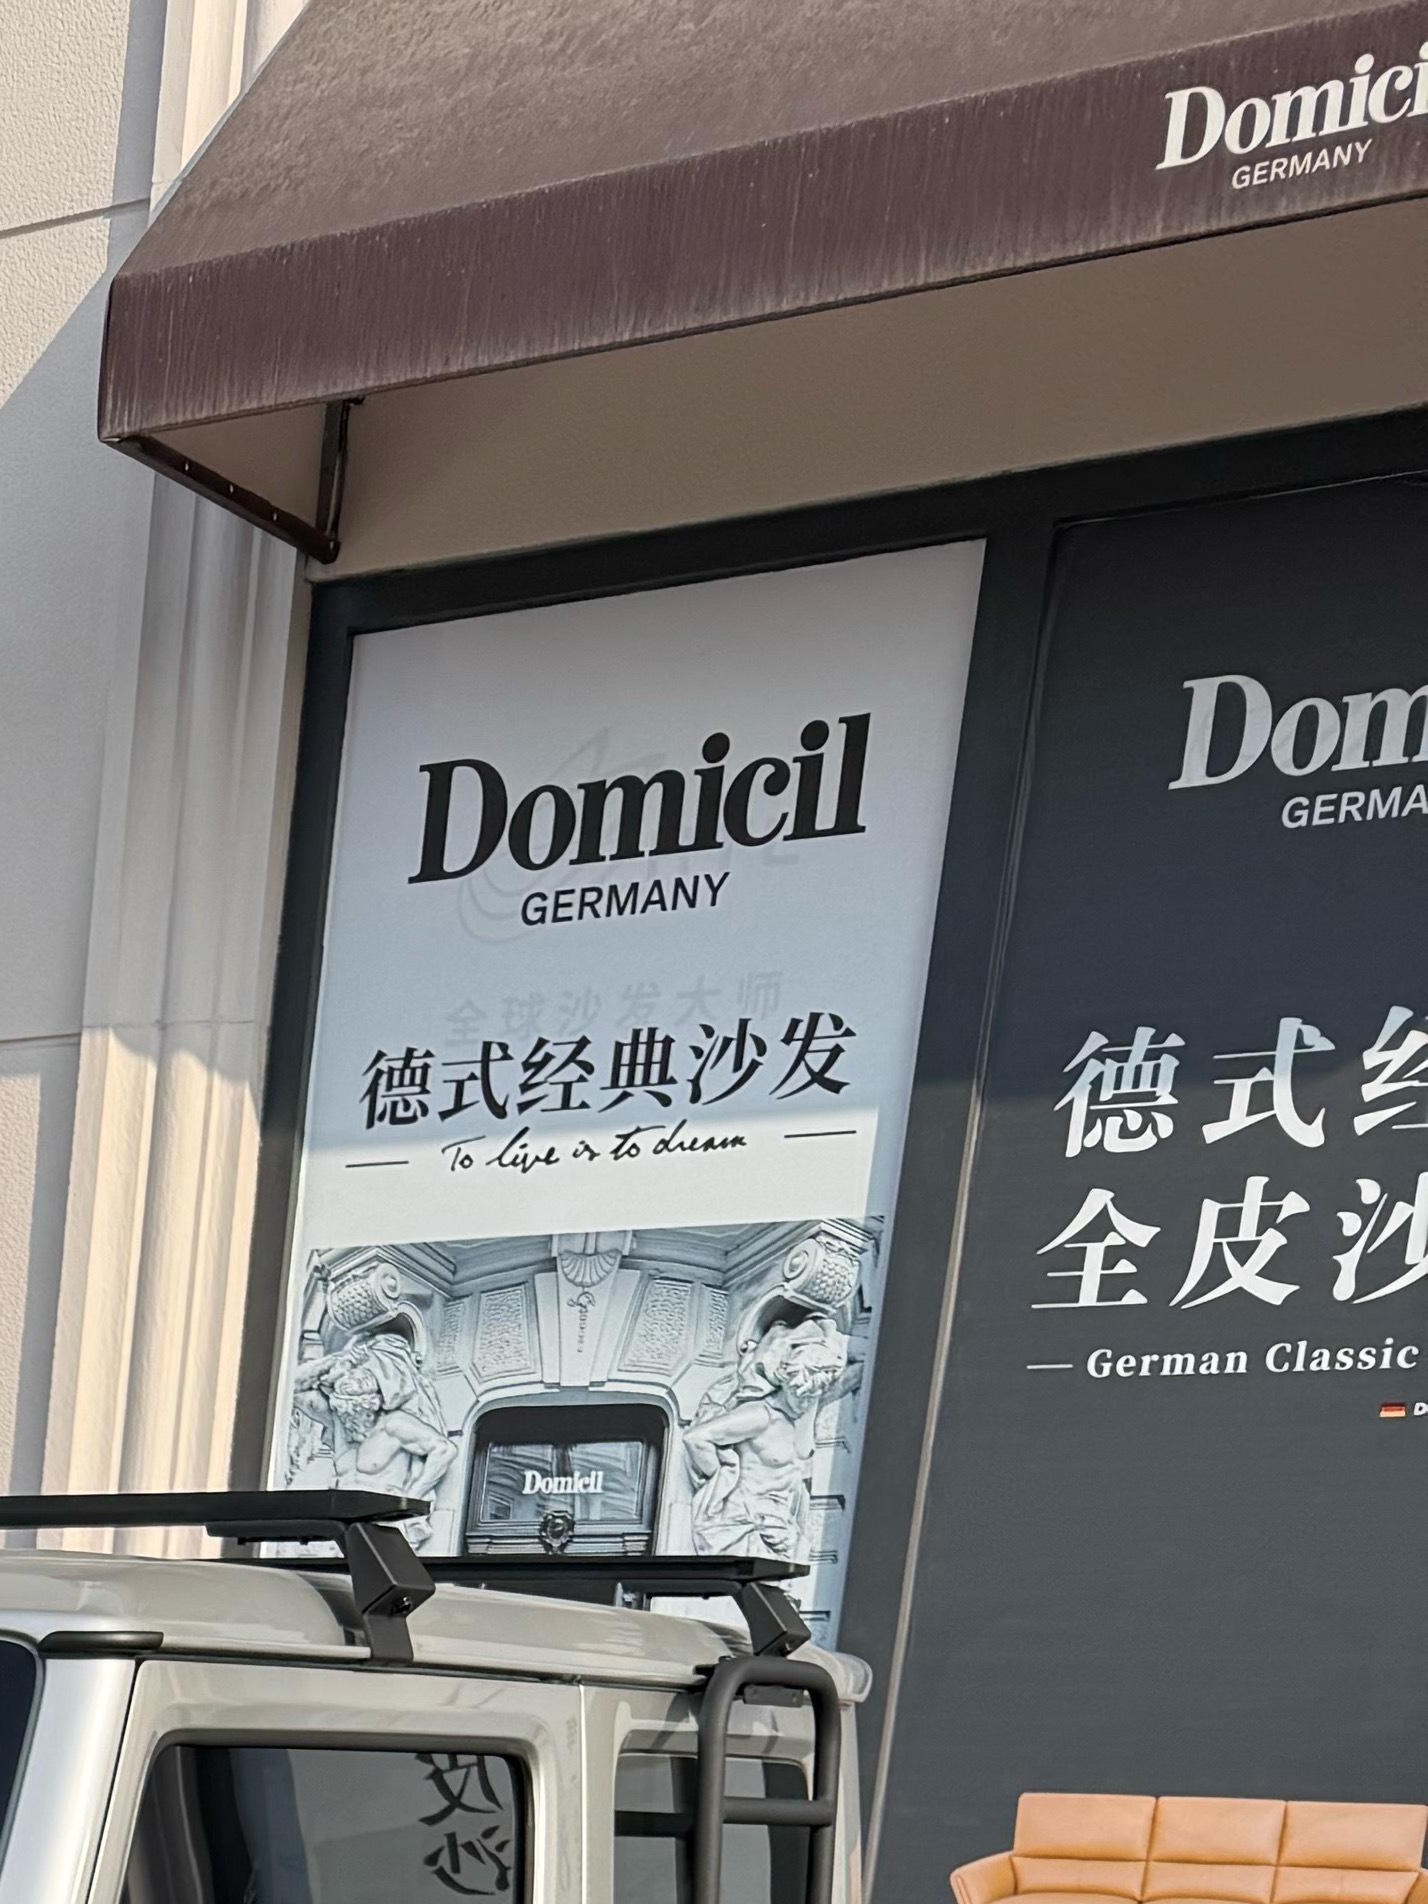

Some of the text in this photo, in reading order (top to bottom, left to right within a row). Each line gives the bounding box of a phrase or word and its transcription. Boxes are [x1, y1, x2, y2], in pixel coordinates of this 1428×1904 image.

[1232, 138, 1372, 189] GERMANY
[407, 713, 872, 884] Domicil
[521, 871, 730, 926] GERMANY
[360, 1011, 858, 1130] 德式经典沙发
[441, 1135, 487, 1172] To
[486, 1127, 560, 1173] live
[611, 1125, 666, 1161] to
[652, 1119, 748, 1156] dream
[1087, 1337, 1420, 1379] German Classic
[522, 1470, 604, 1495] Domicil
